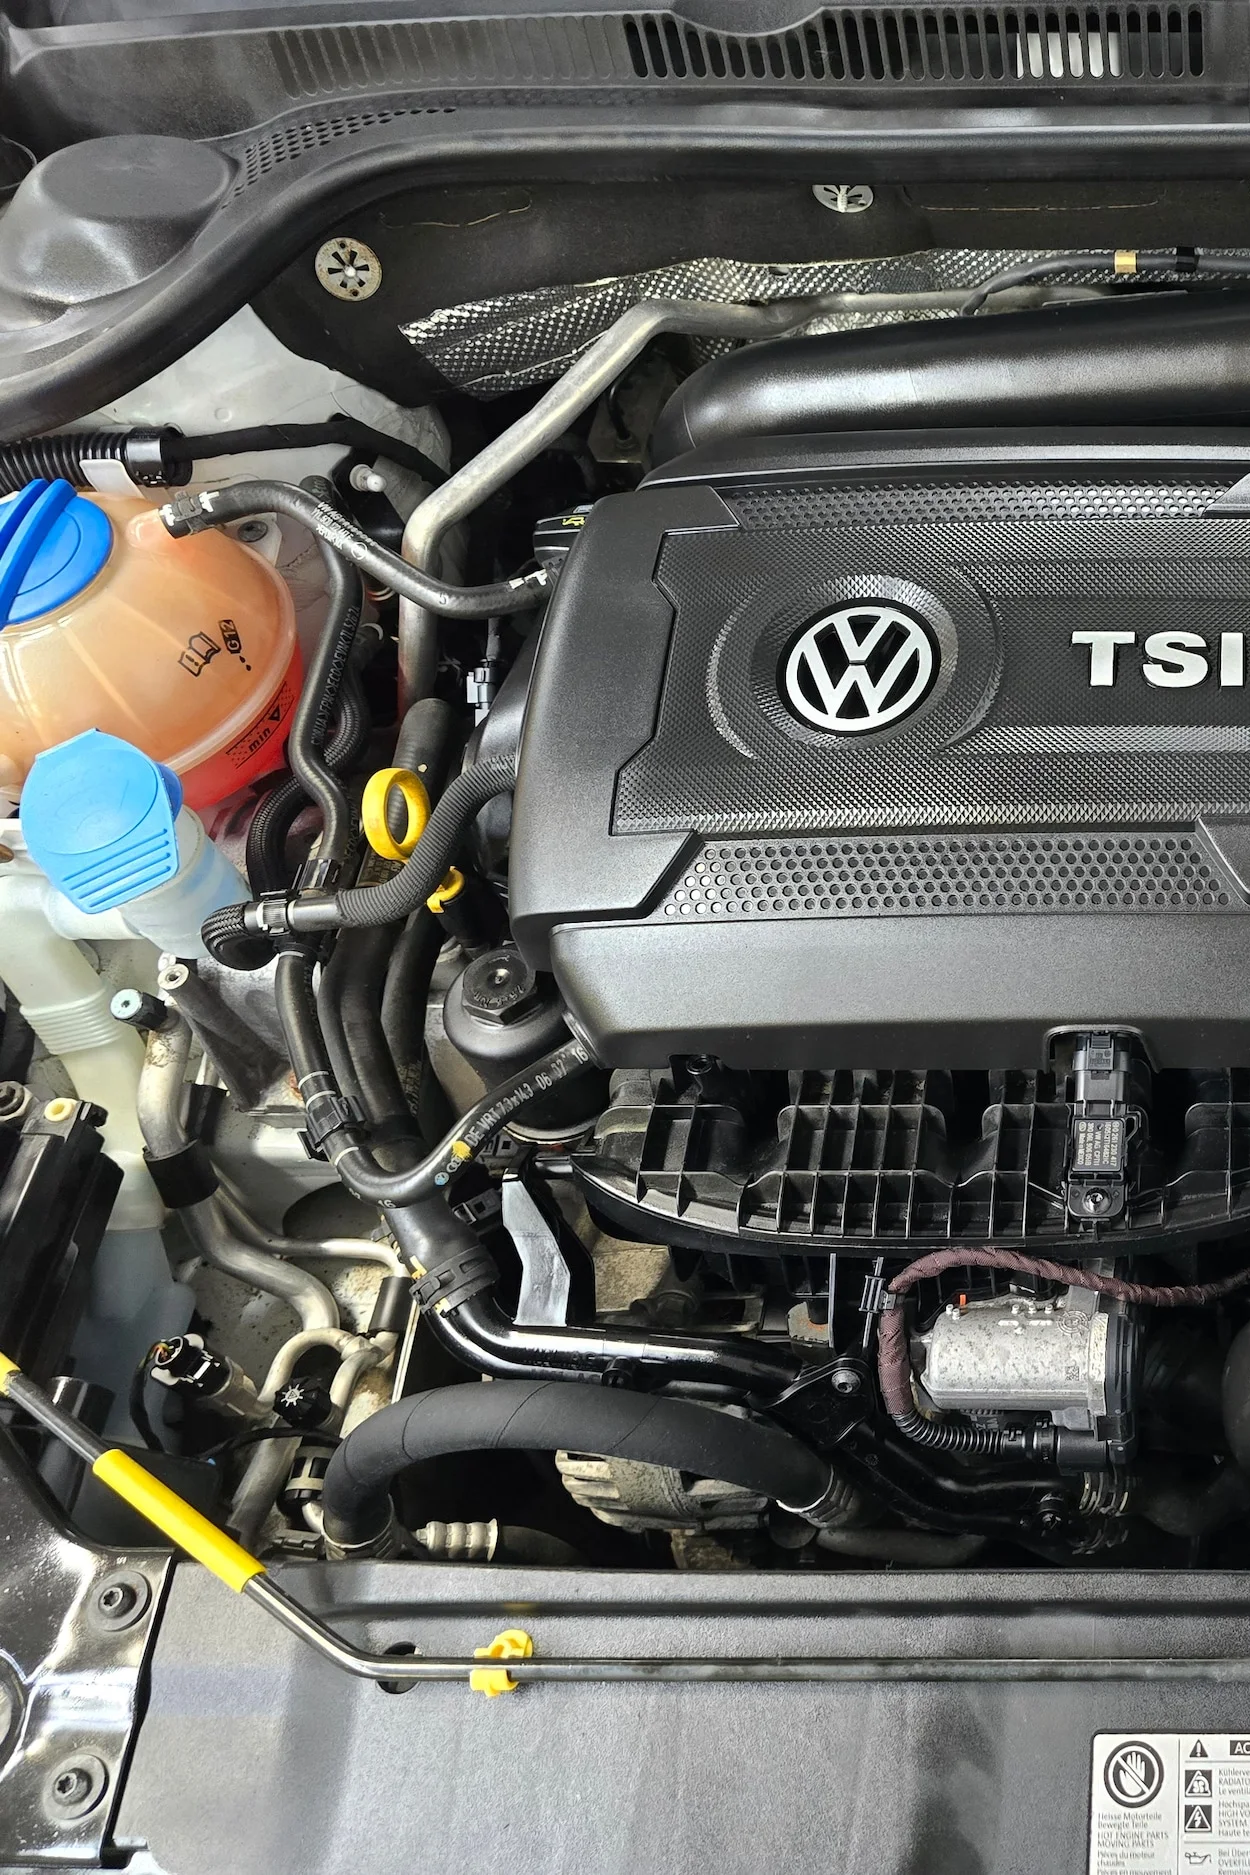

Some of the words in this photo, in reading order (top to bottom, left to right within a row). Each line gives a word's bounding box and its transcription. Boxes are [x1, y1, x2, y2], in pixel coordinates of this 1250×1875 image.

[219, 619, 241, 652] G12
[1072, 631, 1245, 688] TSI
[248, 726, 271, 753] min
[463, 1126, 485, 1148] DE
[477, 1110, 501, 1131] VRT
[535, 1072, 553, 1091] 06
[572, 1046, 589, 1065] 16
[1219, 1787, 1226, 1795] Le
[1098, 1811, 1122, 1820] Heisse
[1123, 1811, 1162, 1820] Motorteile
[1098, 1821, 1130, 1830] Bewegte
[1132, 1821, 1148, 1829] Teile
[1097, 1831, 1113, 1839] HOT
[1115, 1831, 1144, 1839] ENGINE
[1146, 1831, 1169, 1839] PARTS
[1218, 1829, 1241, 1837] Haute
[1097, 1840, 1130, 1848] MOVING
[1132, 1840, 1154, 1848] PARTS
[1119, 1850, 1128, 1858] du
[1130, 1850, 1154, 1859] moteur
[1218, 1849, 1229, 1857] Bei
